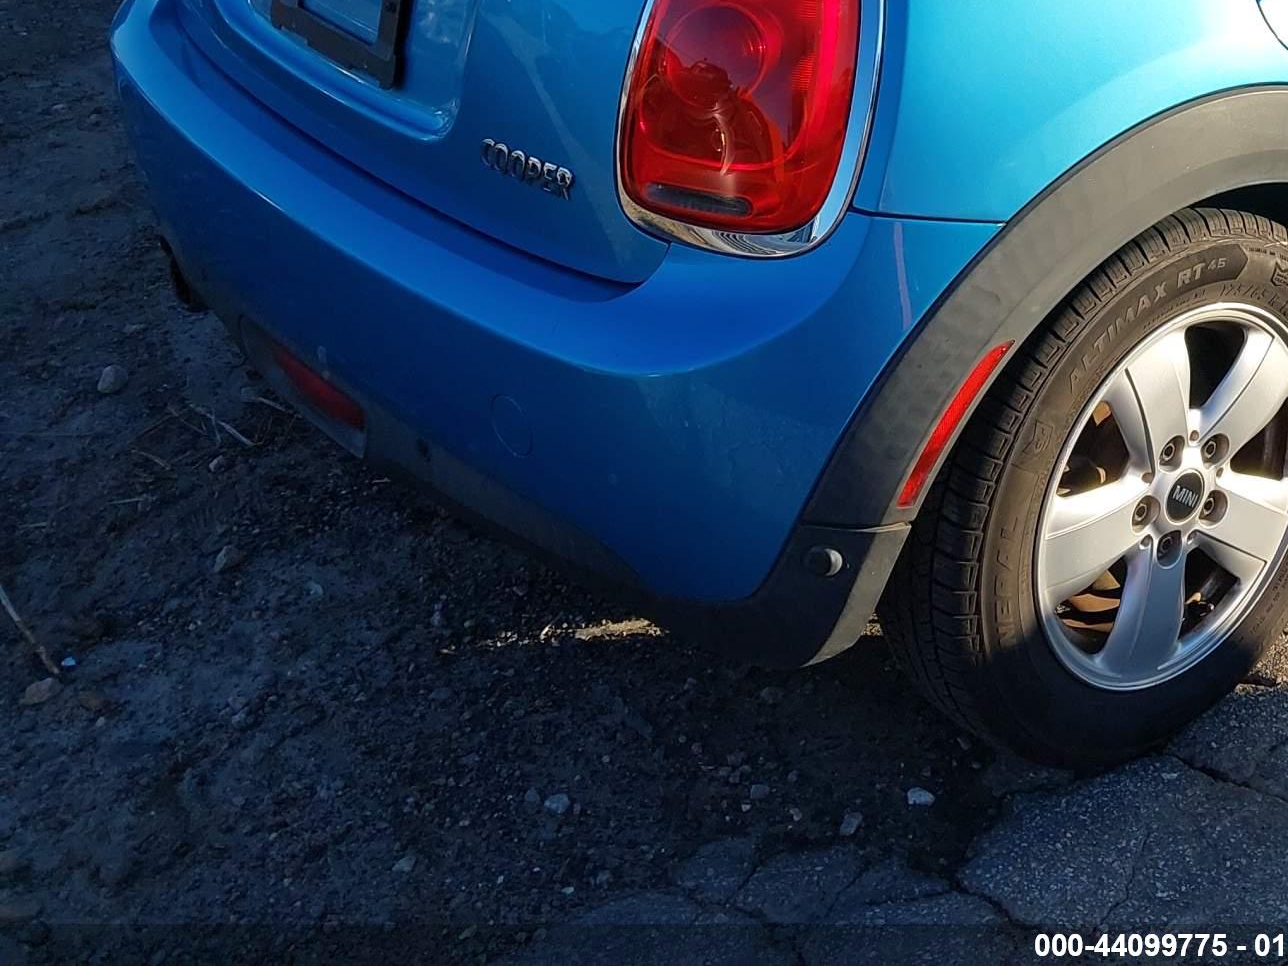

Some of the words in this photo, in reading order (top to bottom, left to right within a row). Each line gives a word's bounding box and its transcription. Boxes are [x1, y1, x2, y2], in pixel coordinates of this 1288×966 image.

[480, 138, 573, 201] COOPER
[1069, 281, 1168, 395] ALTIMAX
[1172, 484, 1200, 508] MINI
